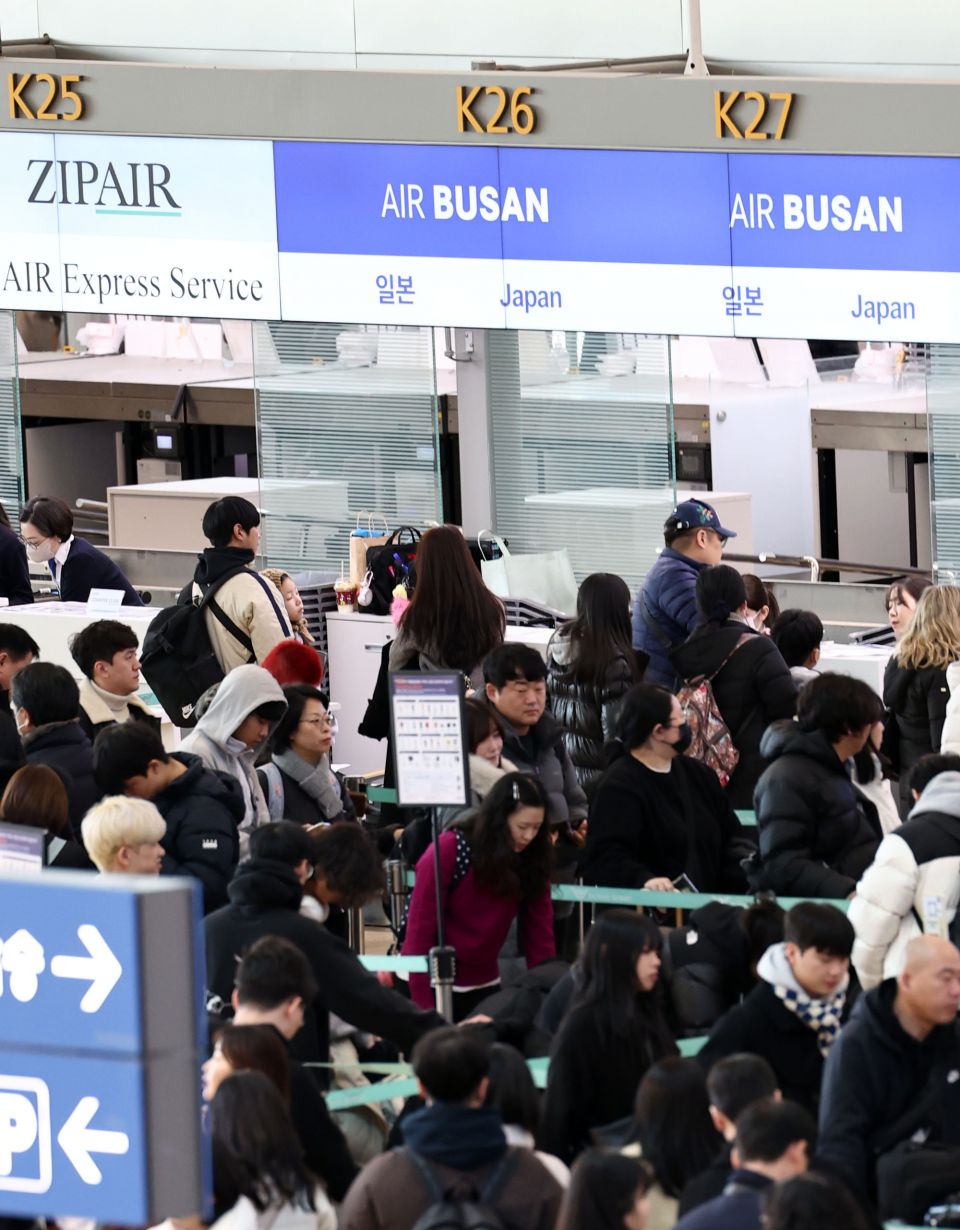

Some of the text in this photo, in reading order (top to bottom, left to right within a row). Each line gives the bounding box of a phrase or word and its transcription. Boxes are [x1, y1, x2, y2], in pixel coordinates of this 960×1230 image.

[7, 72, 83, 121] K25
[456, 85, 535, 135] K26
[714, 90, 793, 140] K27
[27, 159, 182, 209] ZIPAIR
[381, 183, 549, 223] AIR BUSAN
[730, 193, 903, 233] AIR BUSAN
[63, 264, 161, 304] Express
[170, 267, 263, 302] Service
[375, 274, 562, 314] 일본 Japan
[722, 286, 915, 325] 일본 Japan
